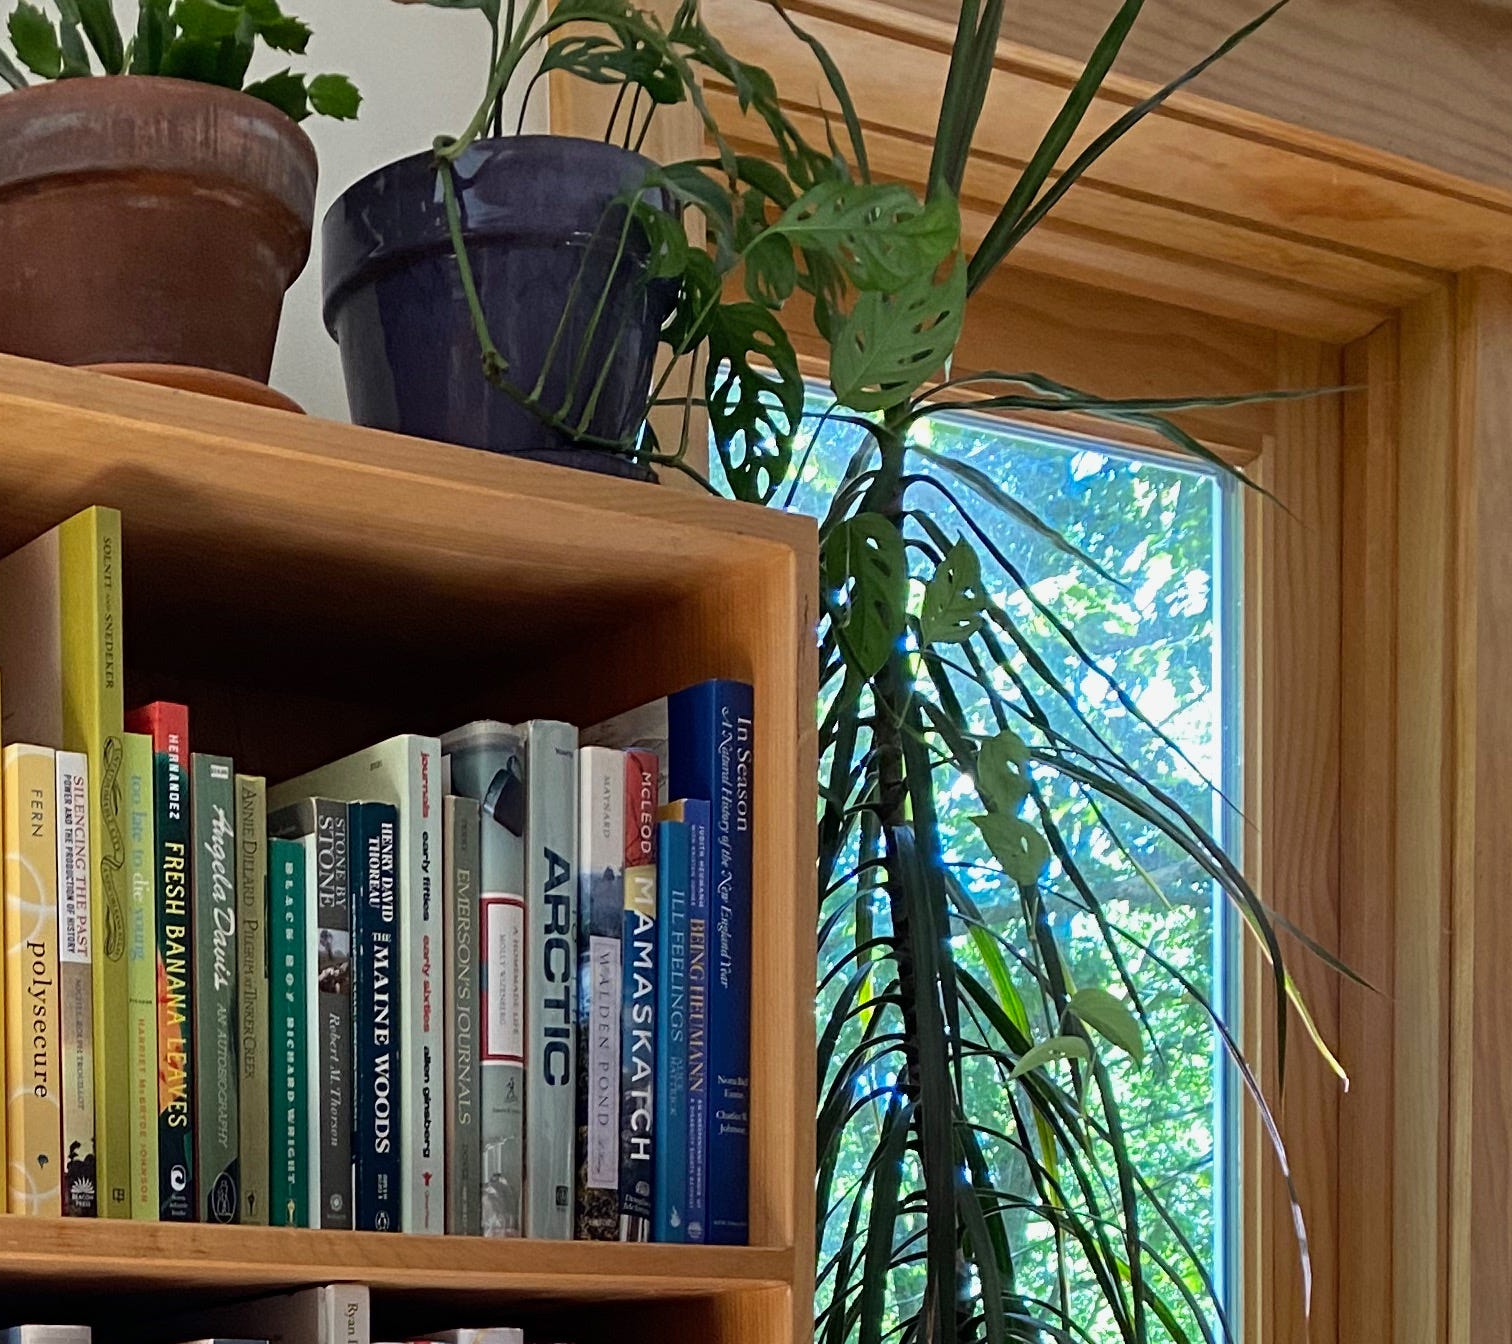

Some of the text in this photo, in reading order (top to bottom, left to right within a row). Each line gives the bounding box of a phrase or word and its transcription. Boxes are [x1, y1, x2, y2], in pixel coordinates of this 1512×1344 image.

[30, 789, 44, 838] FERN
[167, 734, 180, 820] HERNANDEZ
[163, 842, 187, 1128] FRESH BANANA LEAVES
[205, 805, 235, 991] Angela Davis
[543, 847, 571, 1086] ARCTIC
[28, 941, 55, 1098] polysecure
[373, 946, 391, 1154] MAINE WOODS
[630, 877, 653, 1161] MAMASKATCH
